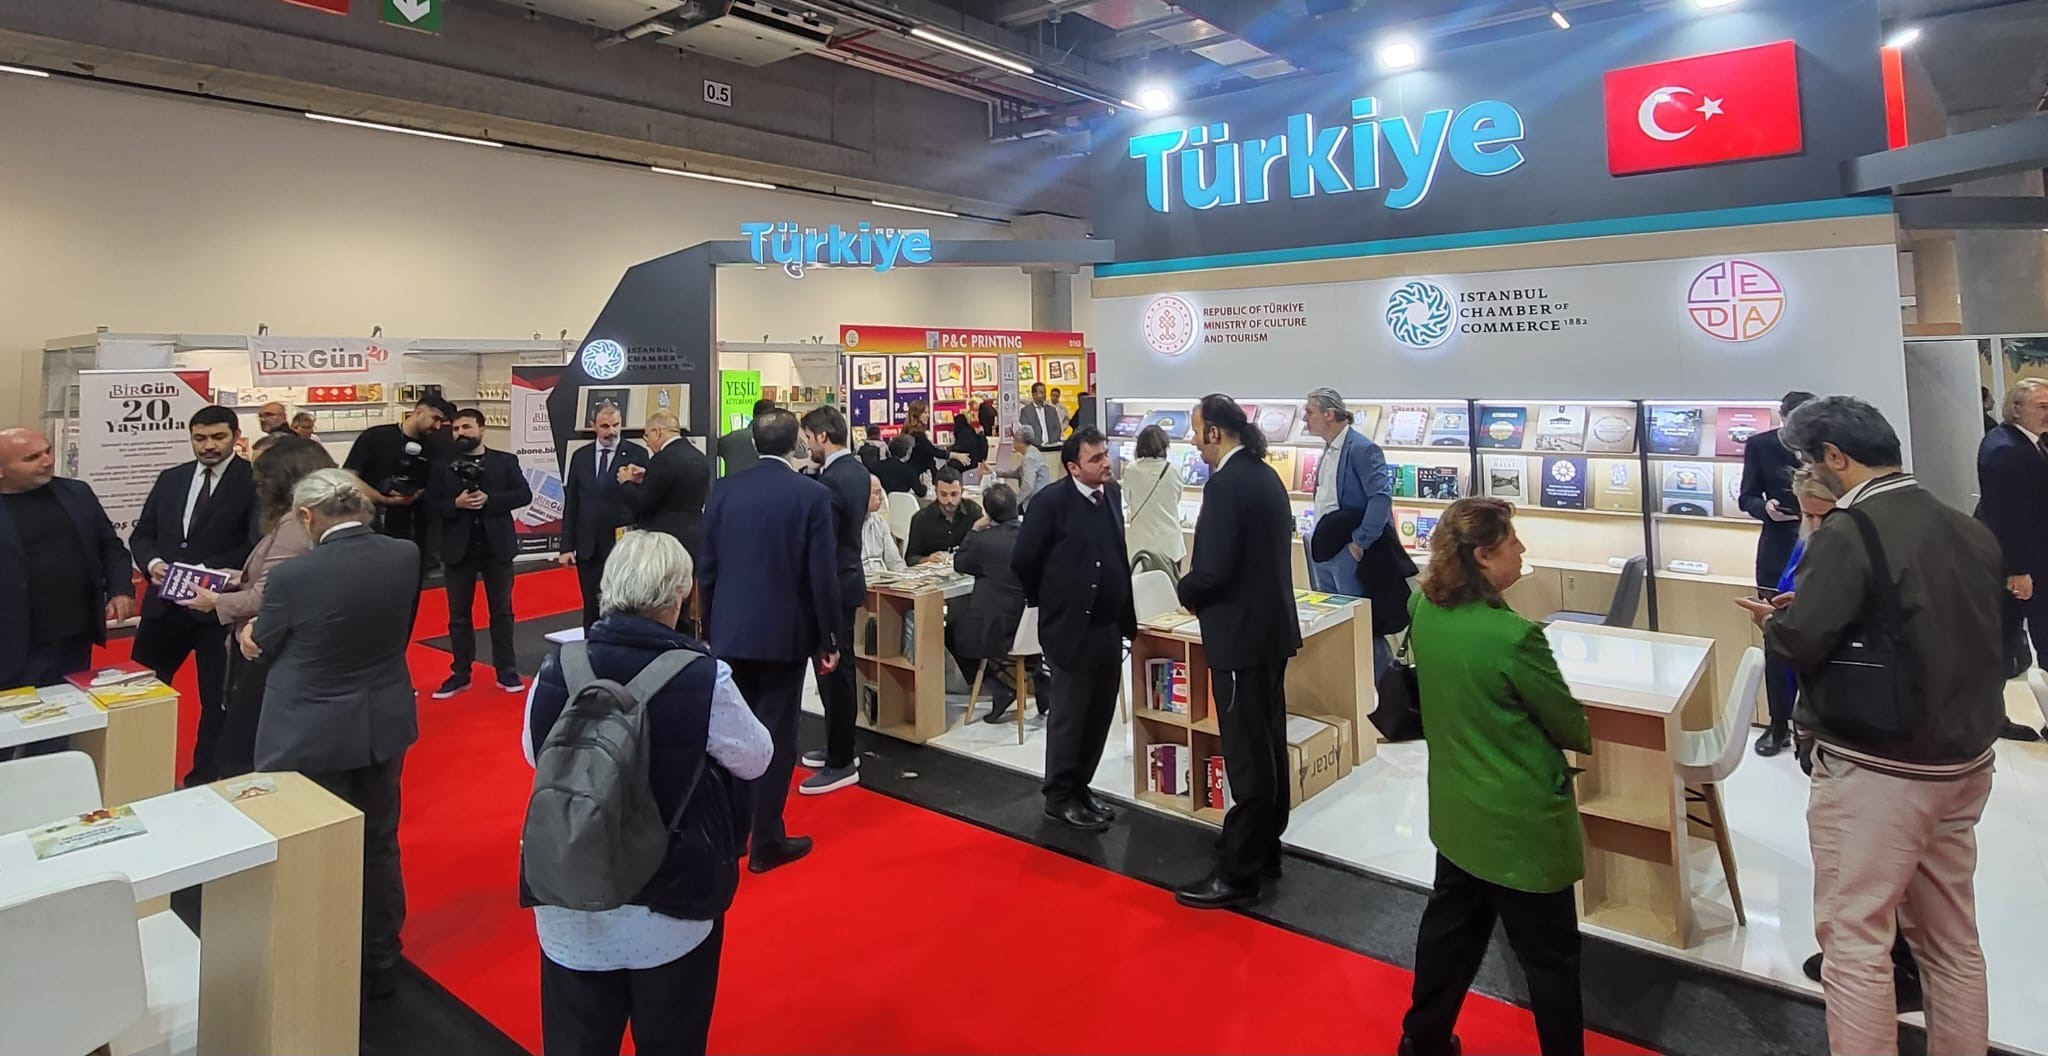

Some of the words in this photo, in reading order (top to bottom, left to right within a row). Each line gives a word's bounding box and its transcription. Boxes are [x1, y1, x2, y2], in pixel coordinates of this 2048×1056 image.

[706, 84, 729, 102] 0.5
[1128, 96, 1526, 213] Türkiye
[740, 220, 933, 273] Türkiye
[1460, 288, 1548, 303] ISTANBUL
[1203, 306, 1247, 317] REPUBLIC
[1249, 305, 1262, 315] OF
[1264, 301, 1305, 314] TÜRKİYE
[1460, 304, 1552, 318] CHAMBER
[1554, 303, 1569, 311] OF
[1203, 320, 1246, 330] MINISTRY
[1249, 319, 1262, 329] OF
[1264, 317, 1307, 328] CULTURE
[1460, 320, 1561, 334] COMMERCE
[1564, 318, 1588, 326] 1882
[942, 333, 968, 348] P&C
[971, 334, 1023, 349] PRINTING
[1204, 334, 1224, 344] AND
[1225, 333, 1268, 343] TOURISM
[366, 345, 389, 362] 20
[726, 377, 758, 399] YEŞİL
[122, 399, 171, 422] 20
[105, 417, 186, 436] Yaşında
